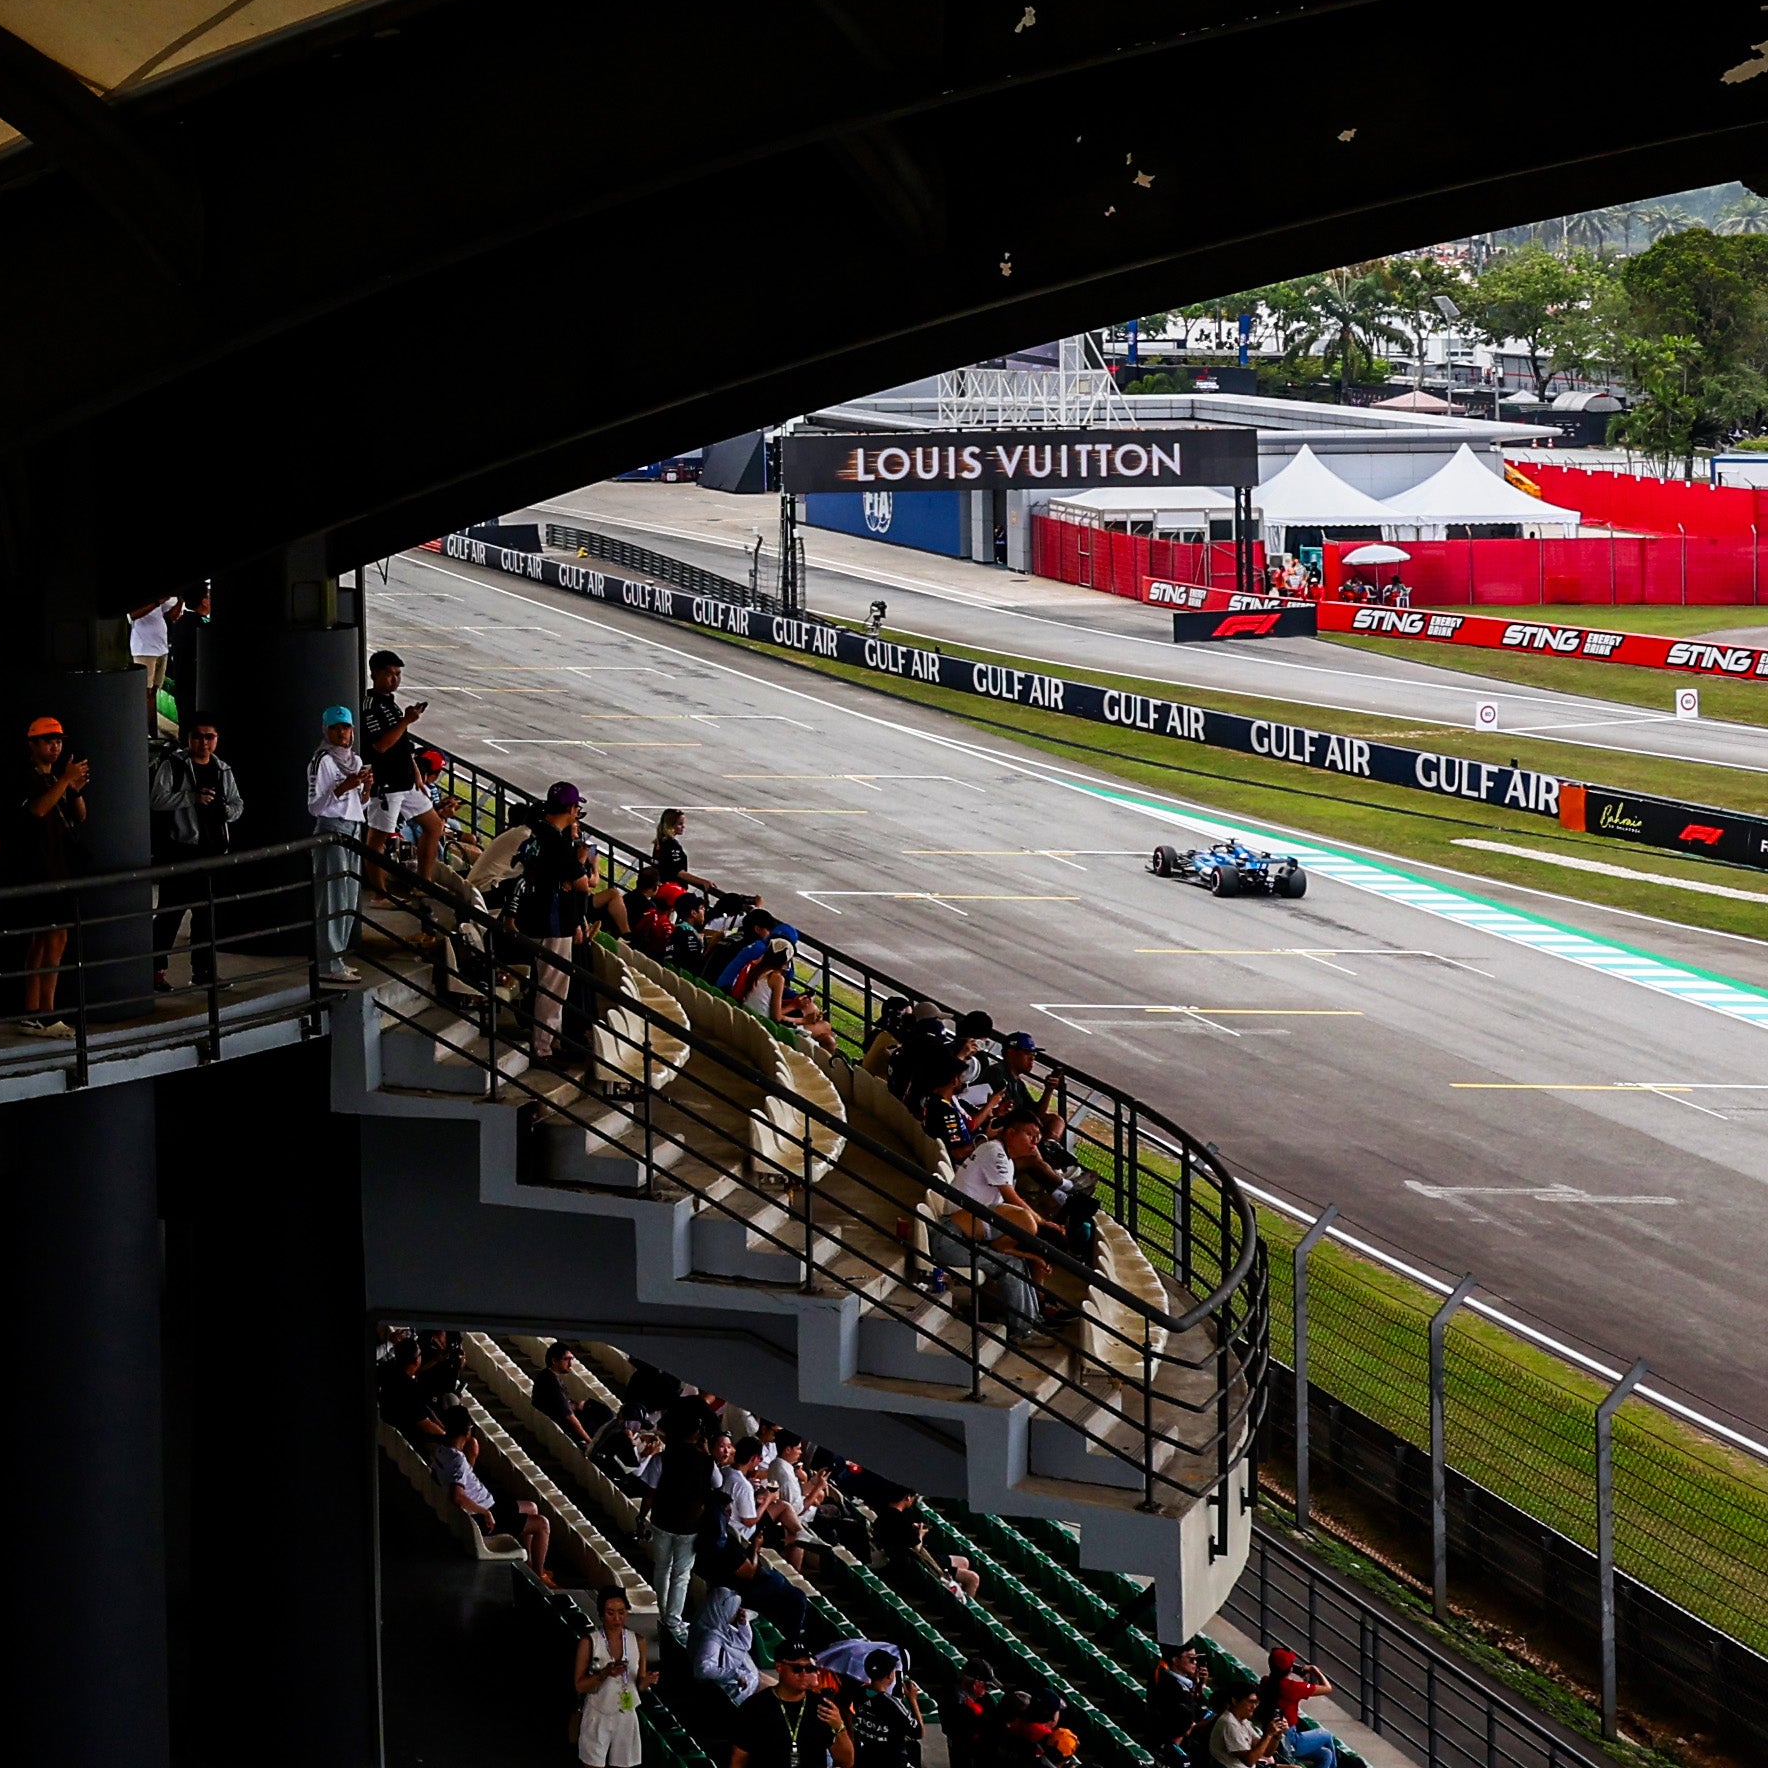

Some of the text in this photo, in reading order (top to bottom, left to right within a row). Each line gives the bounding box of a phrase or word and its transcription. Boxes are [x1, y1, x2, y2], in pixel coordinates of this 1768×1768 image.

[856, 442, 1182, 482] LOUIS VUITTON
[501, 549, 543, 580] GULF AIR
[559, 564, 605, 597] GULF AIR
[623, 580, 673, 615] GULF AIR
[1149, 582, 1186, 605] STING
[693, 597, 749, 636] GULF AIR
[1353, 609, 1424, 633] STING
[1427, 626, 1453, 638] DRINK
[1430, 615, 1463, 629] ENERGY
[772, 617, 838, 657] GULF AIR
[1502, 624, 1580, 652] STING
[1583, 643, 1612, 656] DRINK
[1586, 633, 1623, 647] ENERGY
[864, 639, 940, 682] GULF AIR
[1667, 643, 1752, 672] STING
[973, 663, 1064, 710] GULF AIR
[1102, 690, 1206, 741] GULF AIR
[1250, 720, 1371, 776] GULF AIR
[1415, 753, 1560, 814] GULF AIR
